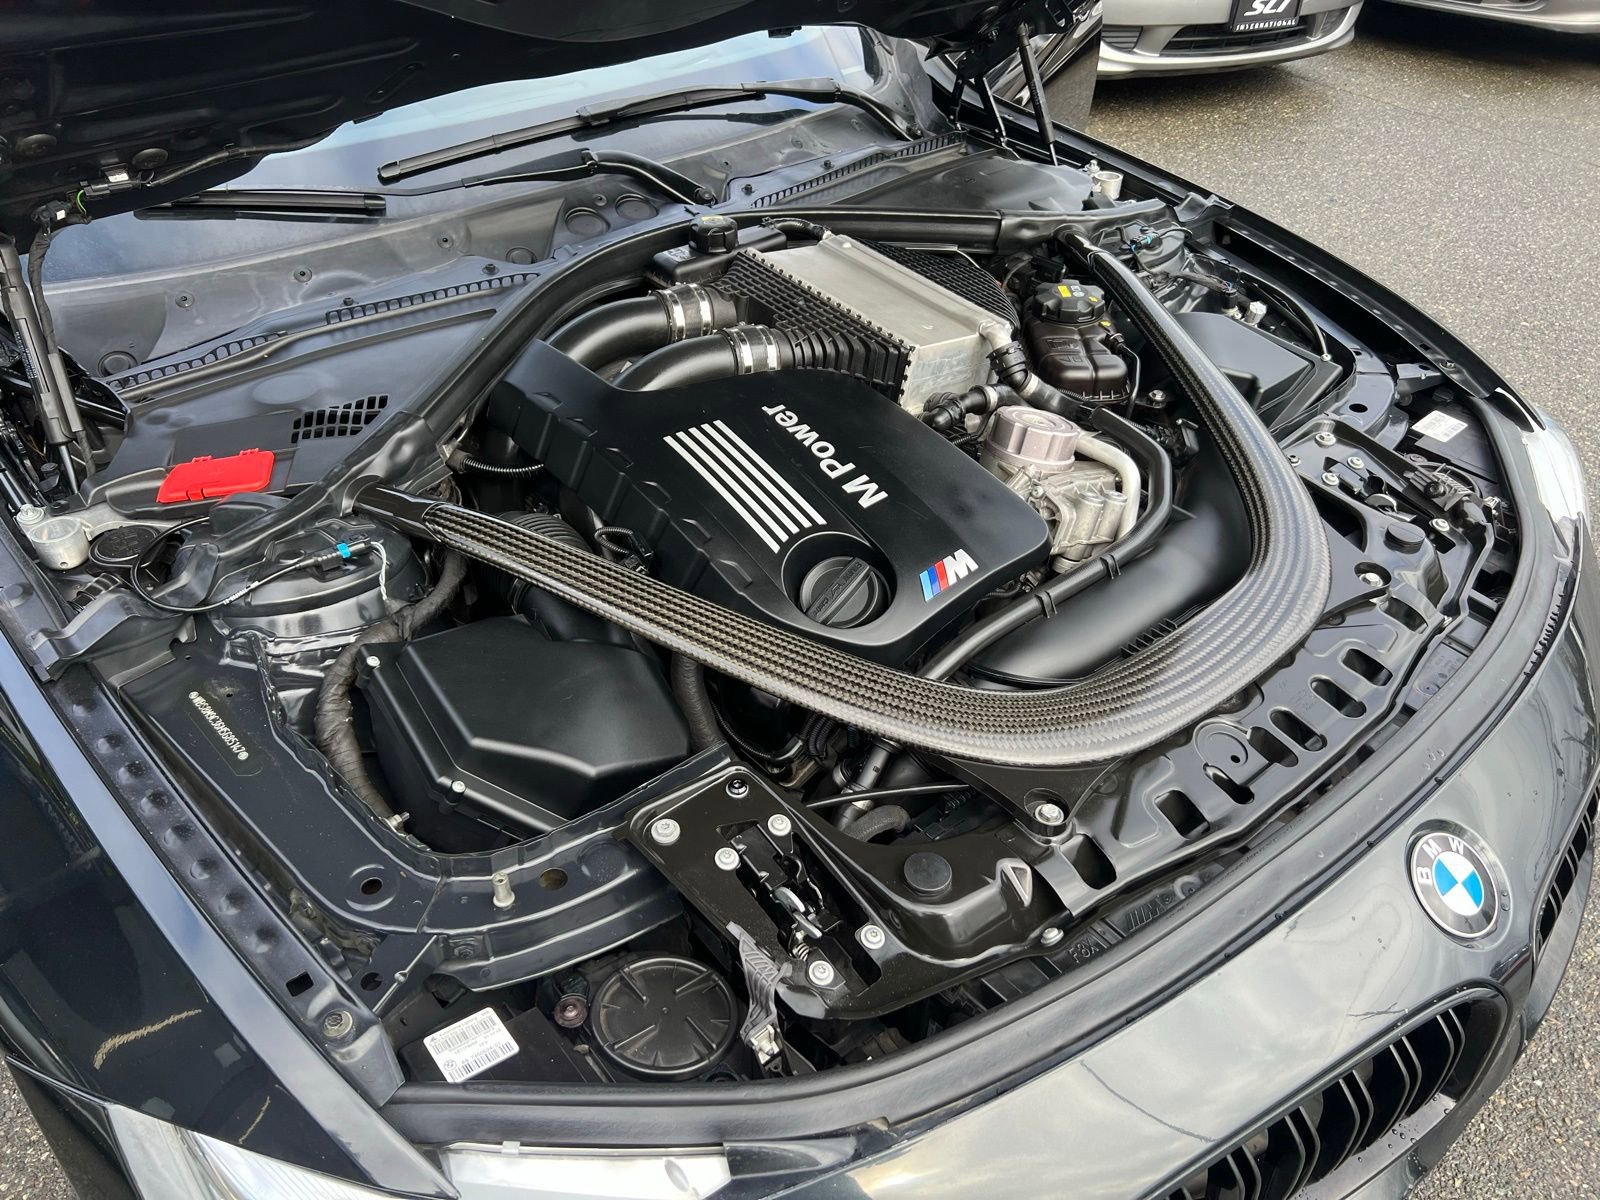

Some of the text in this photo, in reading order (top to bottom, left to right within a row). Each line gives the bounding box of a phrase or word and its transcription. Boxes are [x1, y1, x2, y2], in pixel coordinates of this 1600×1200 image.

[1236, 19, 1296, 31] INTERNATIONAL
[761, 404, 889, 509] M Power
[1416, 836, 1465, 886] BMW
